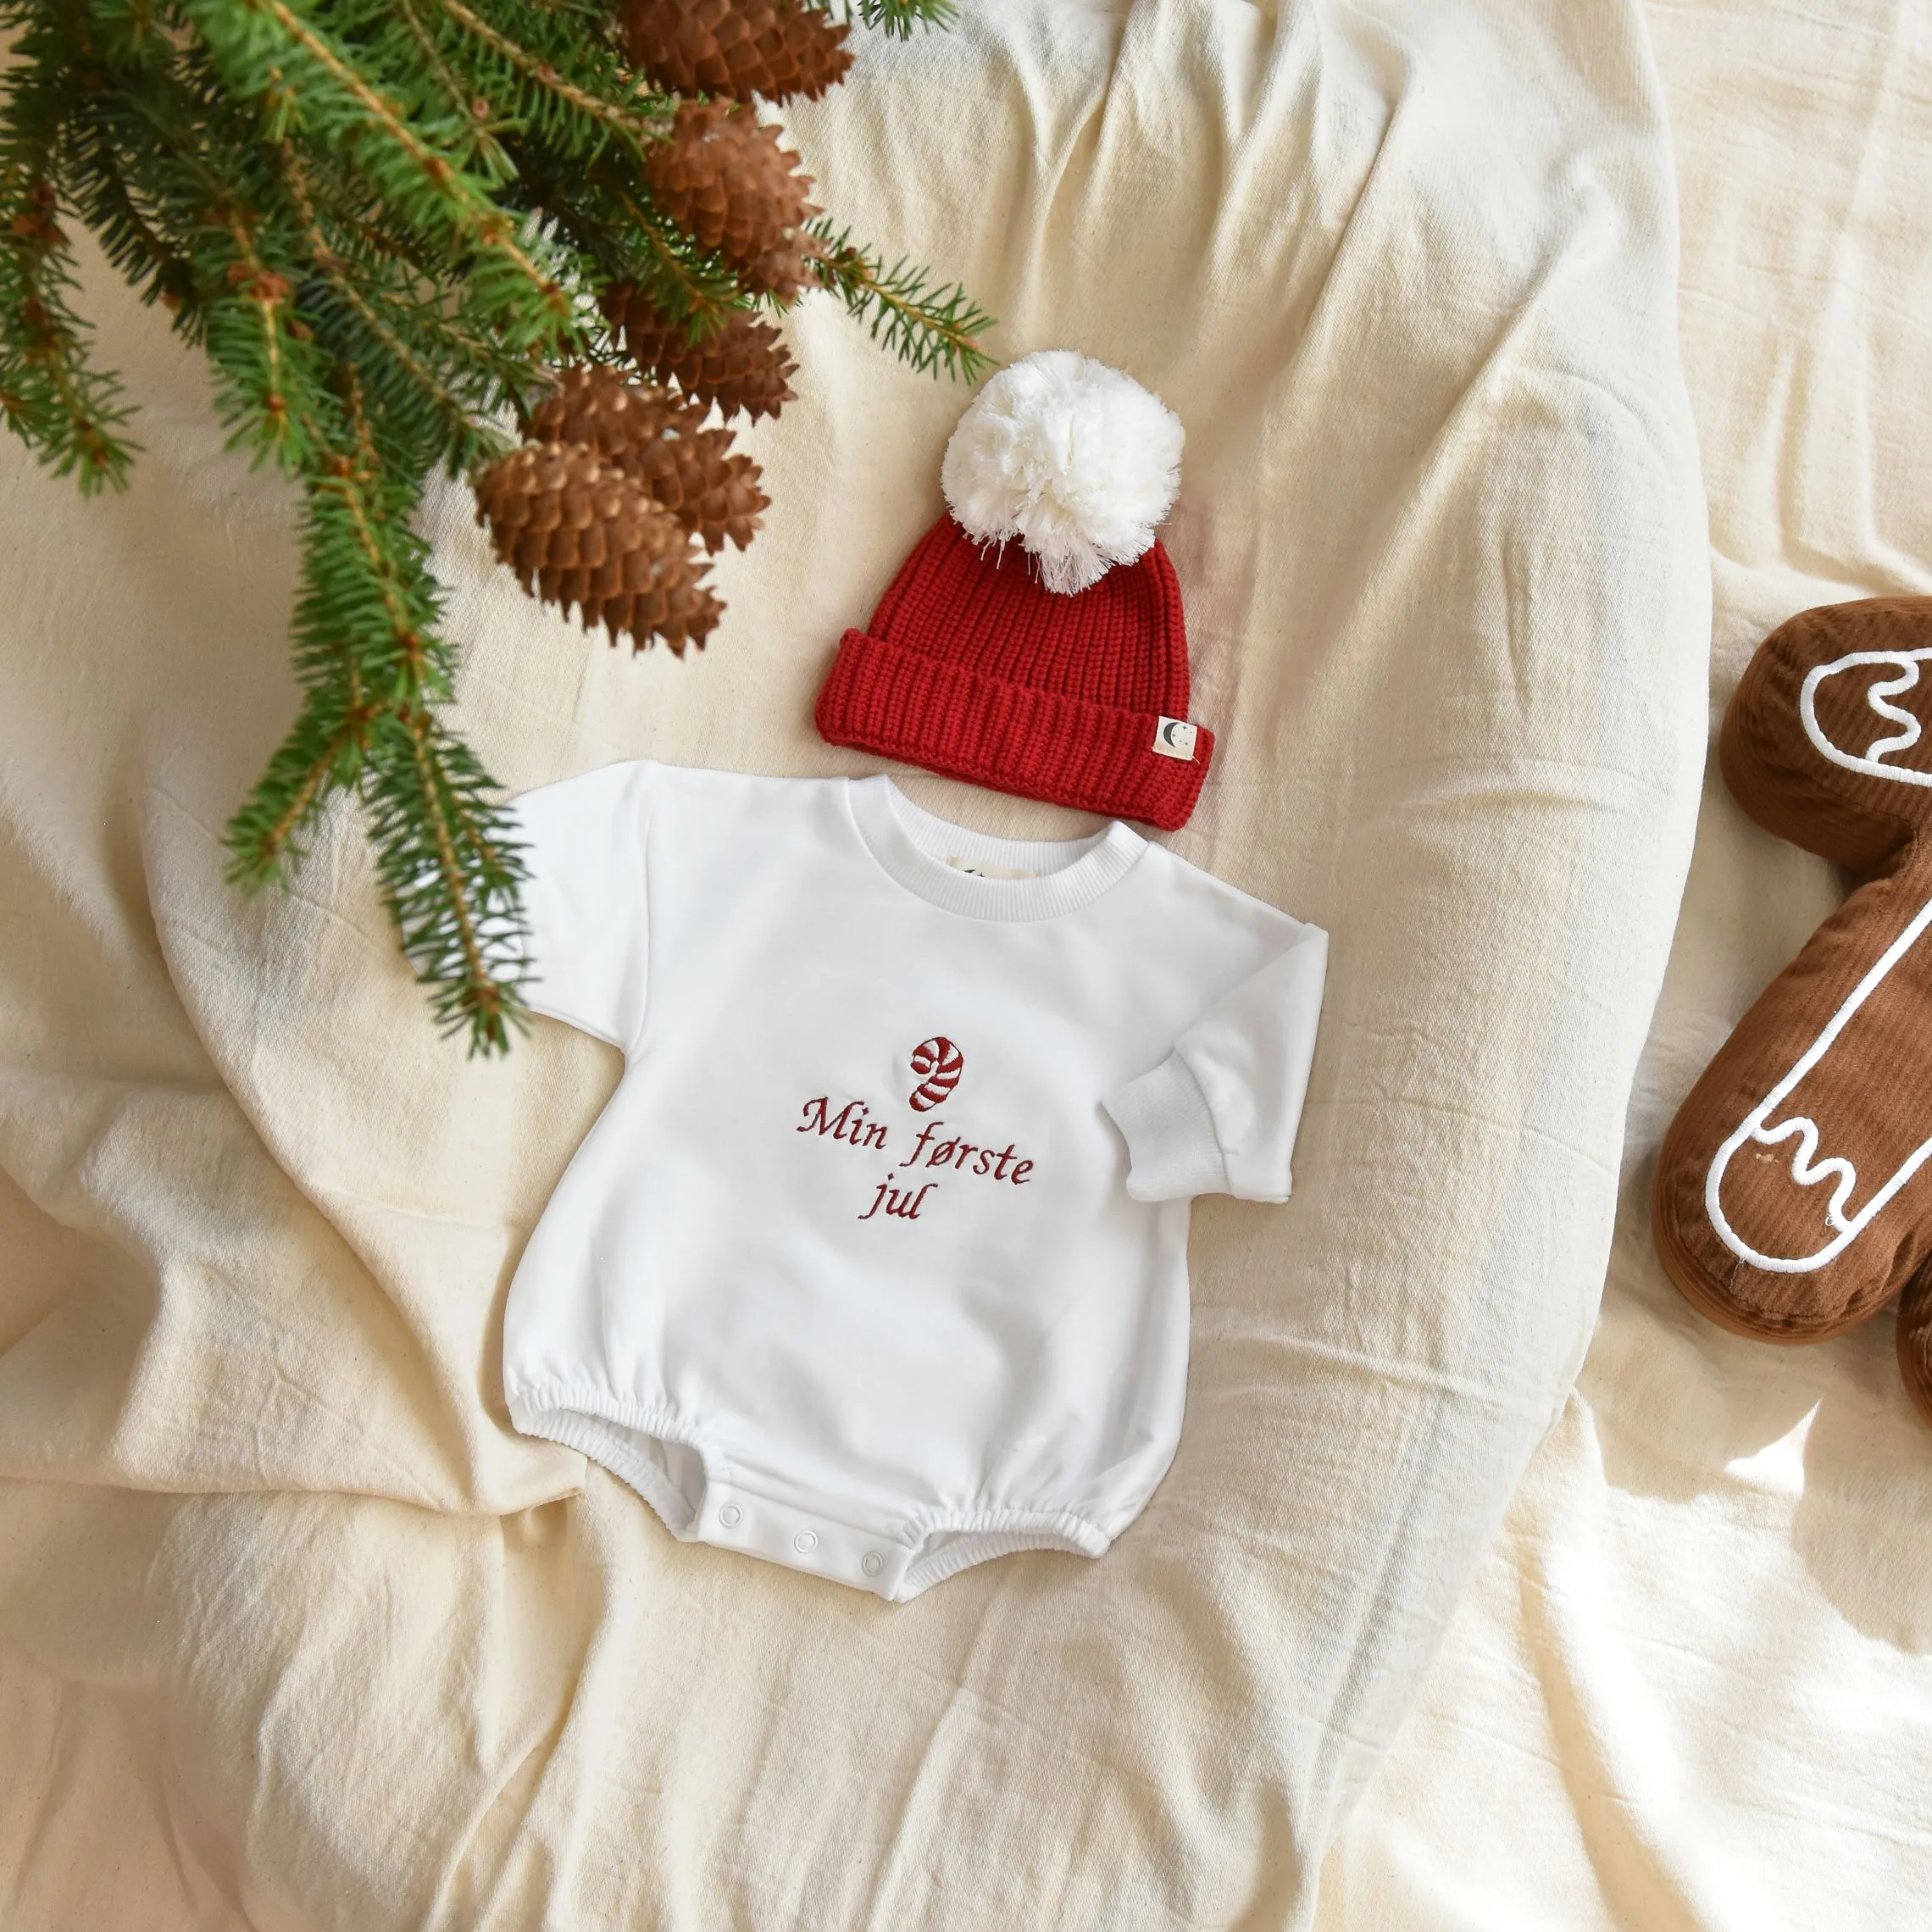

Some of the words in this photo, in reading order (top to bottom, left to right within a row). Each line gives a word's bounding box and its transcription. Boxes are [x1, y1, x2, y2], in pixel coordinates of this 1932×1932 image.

[796, 1096, 888, 1150] Min
[898, 1121, 1035, 1185] første
[857, 1172, 939, 1220] jul
